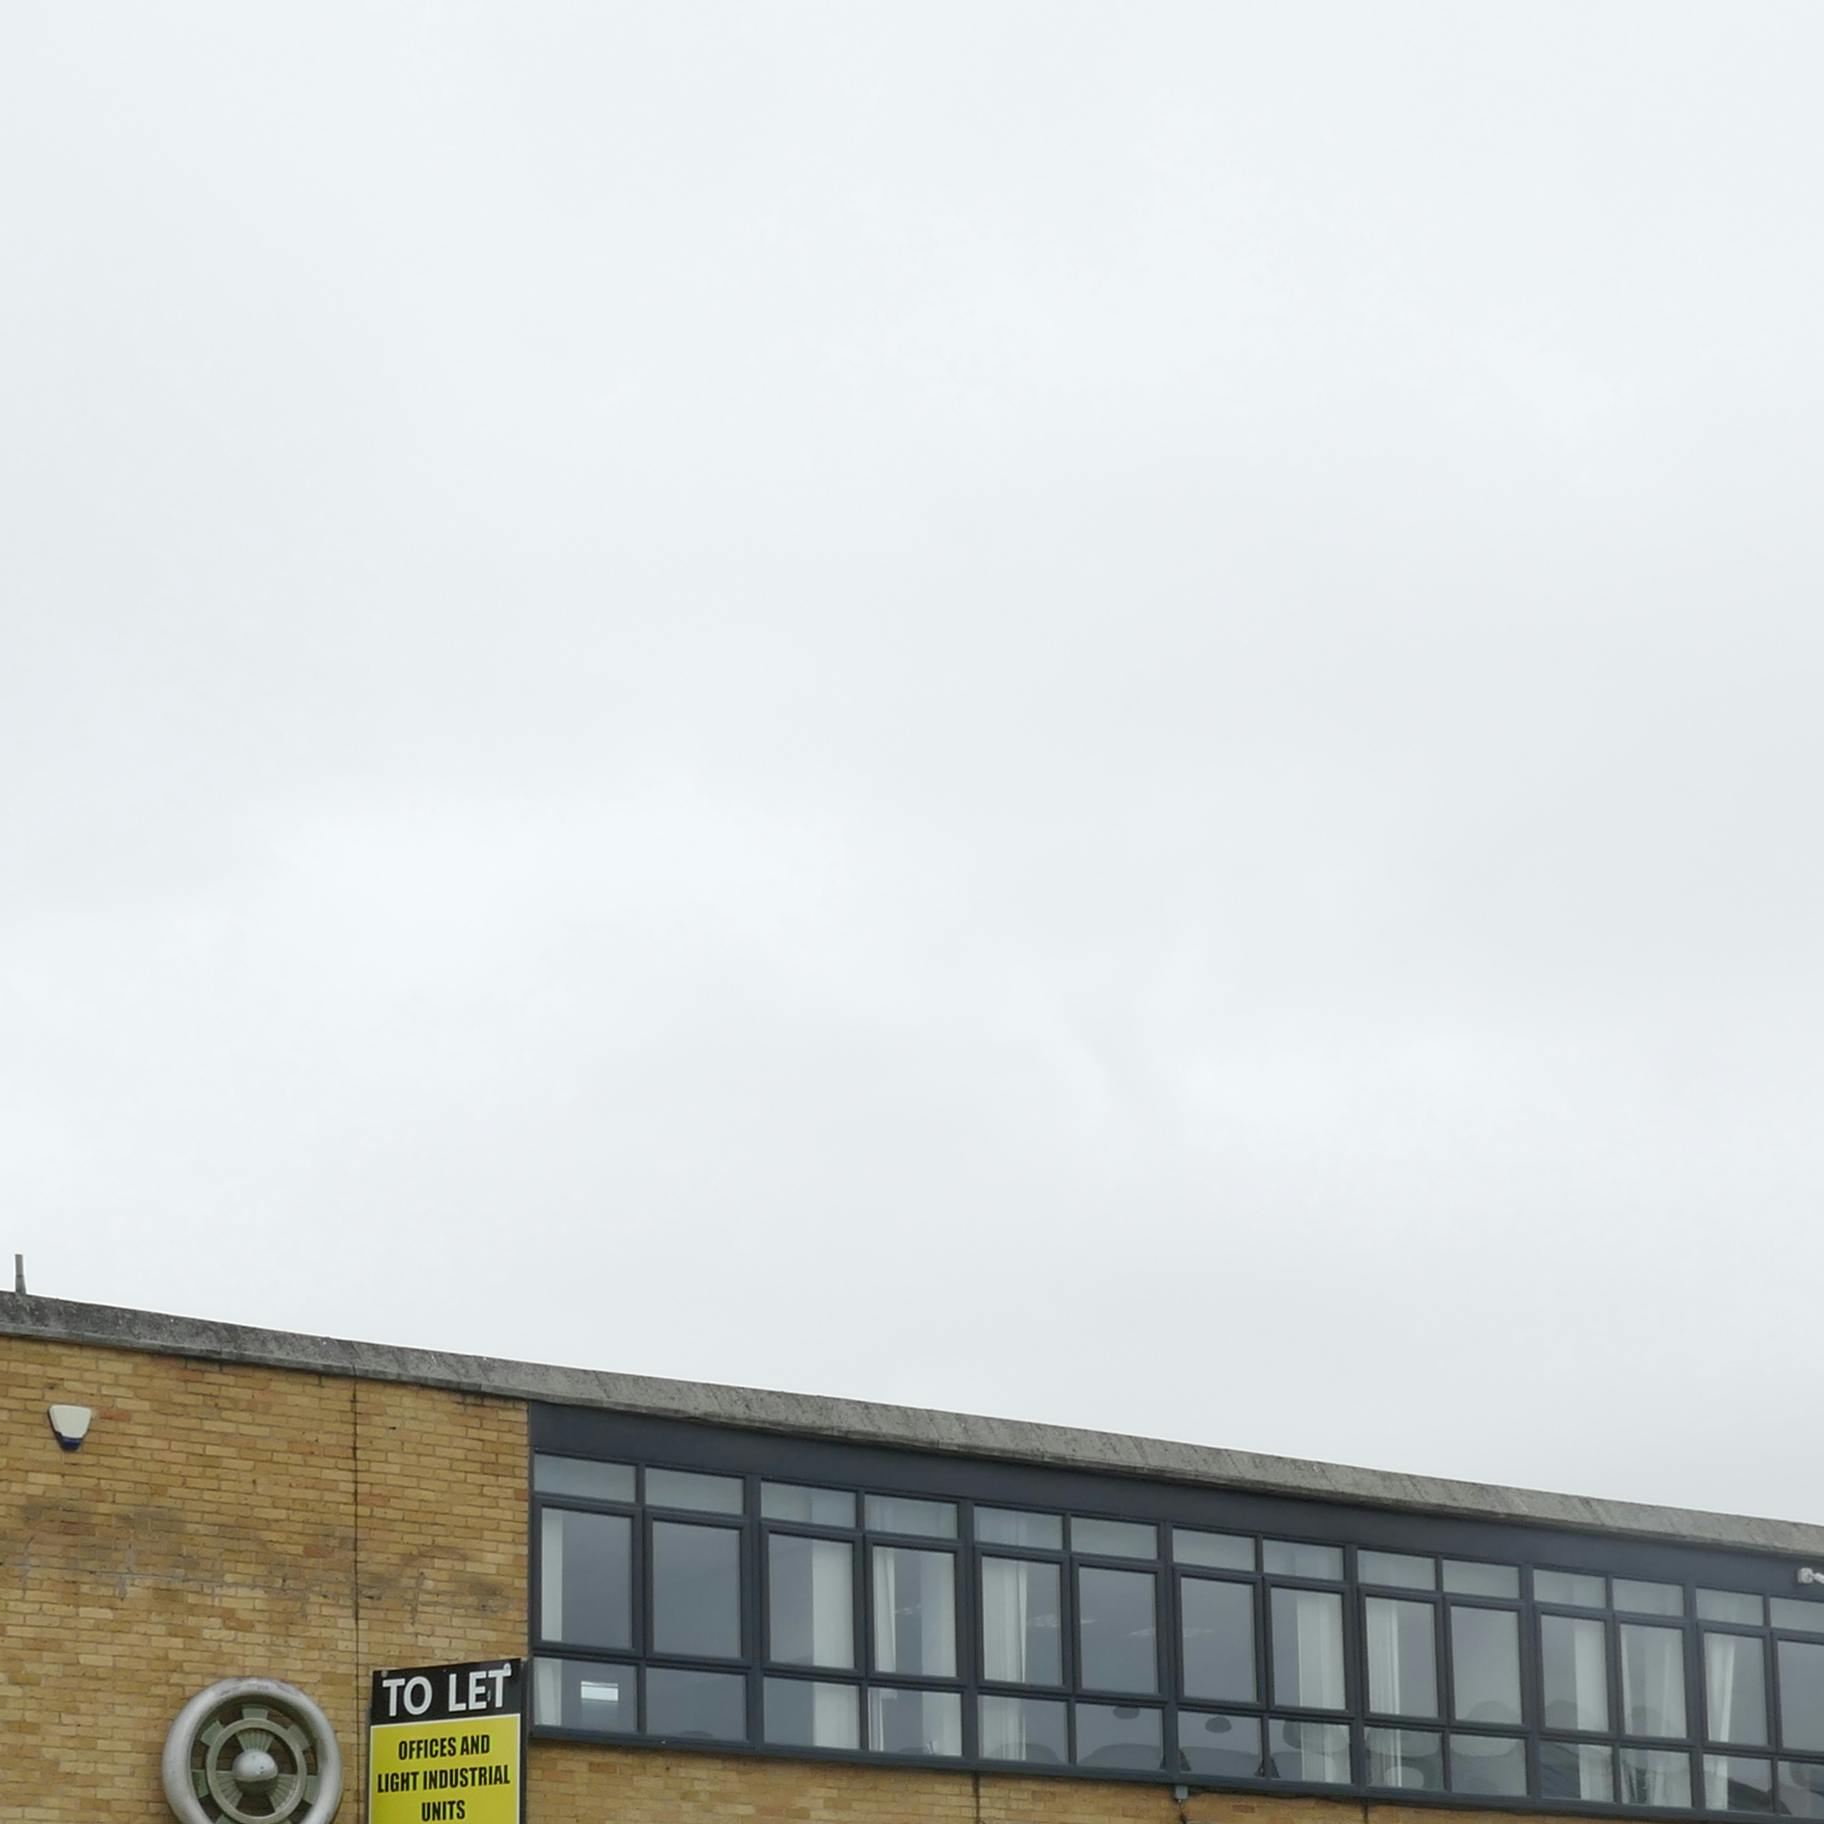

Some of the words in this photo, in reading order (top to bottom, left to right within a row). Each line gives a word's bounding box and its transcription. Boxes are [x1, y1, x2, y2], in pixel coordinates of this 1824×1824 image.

[382, 1675, 433, 1717] TO
[448, 1668, 512, 1712] LET
[398, 1737, 457, 1761] OFFICES
[460, 1734, 490, 1756] AND
[377, 1771, 419, 1793] LIGHT
[423, 1764, 510, 1790] INDUSTRIAL
[421, 1799, 466, 1822] UNITS
